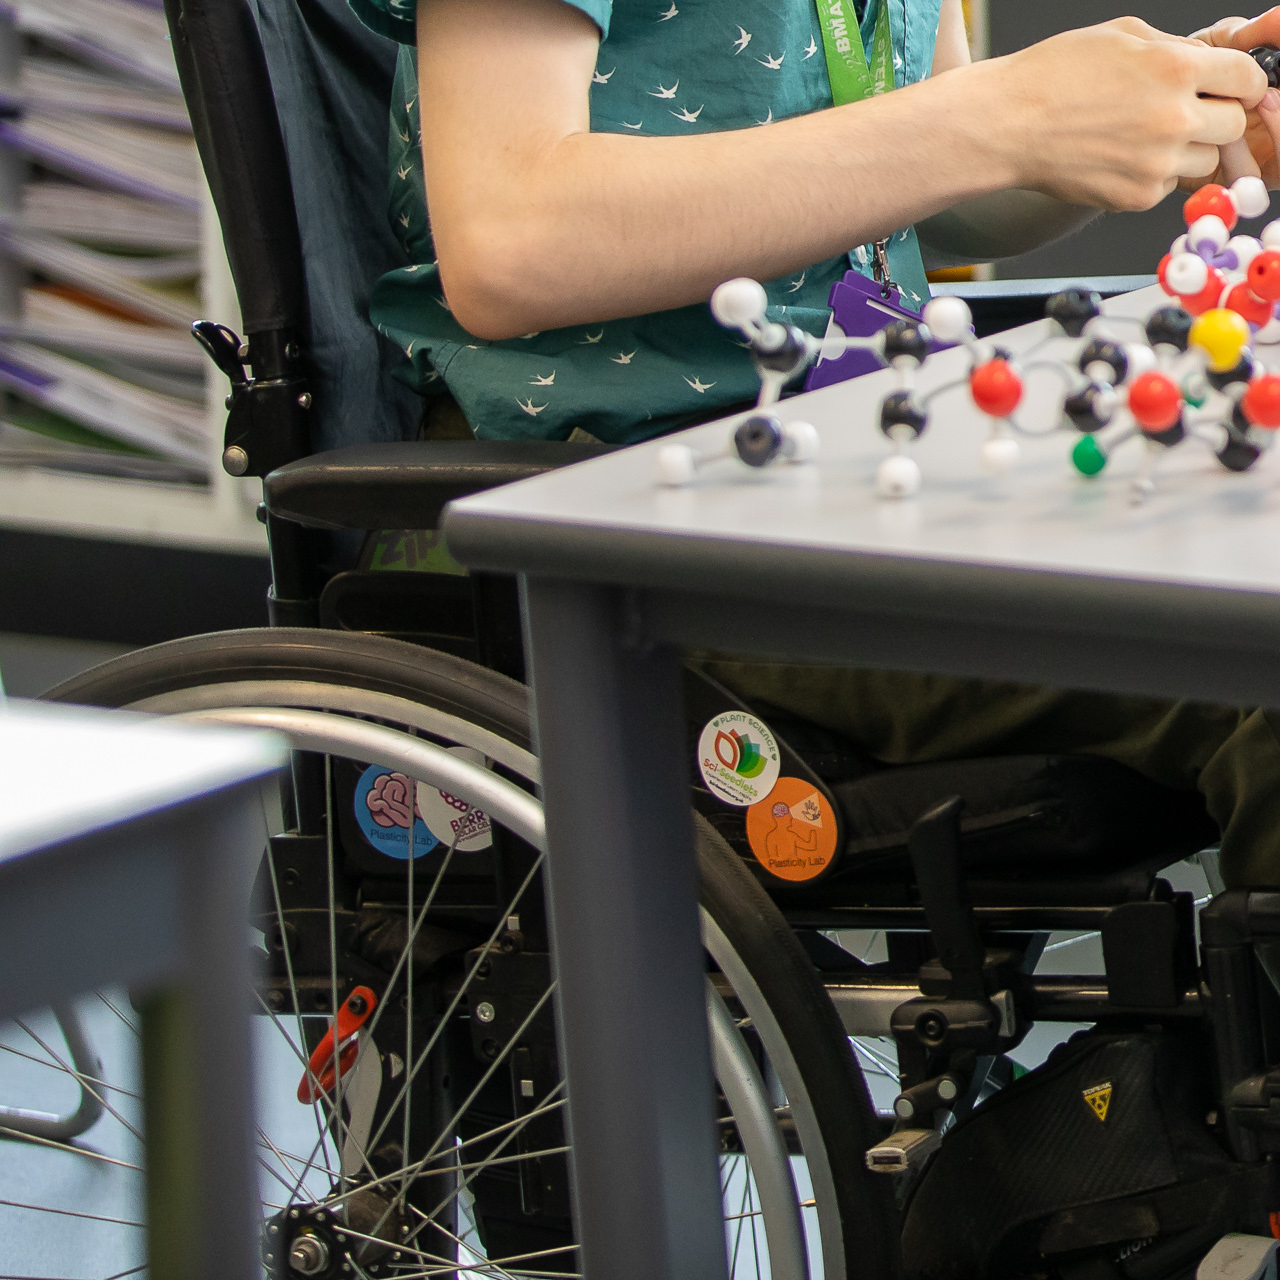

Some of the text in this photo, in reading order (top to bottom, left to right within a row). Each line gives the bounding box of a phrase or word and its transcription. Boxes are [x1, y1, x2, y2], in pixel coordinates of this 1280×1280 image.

[720, 714, 776, 752] PLANT SCIENCE
[450, 810, 486, 832] BERR
[370, 828, 433, 847] Plasticity Lab
[769, 856, 826, 868] Plasticity Lab
